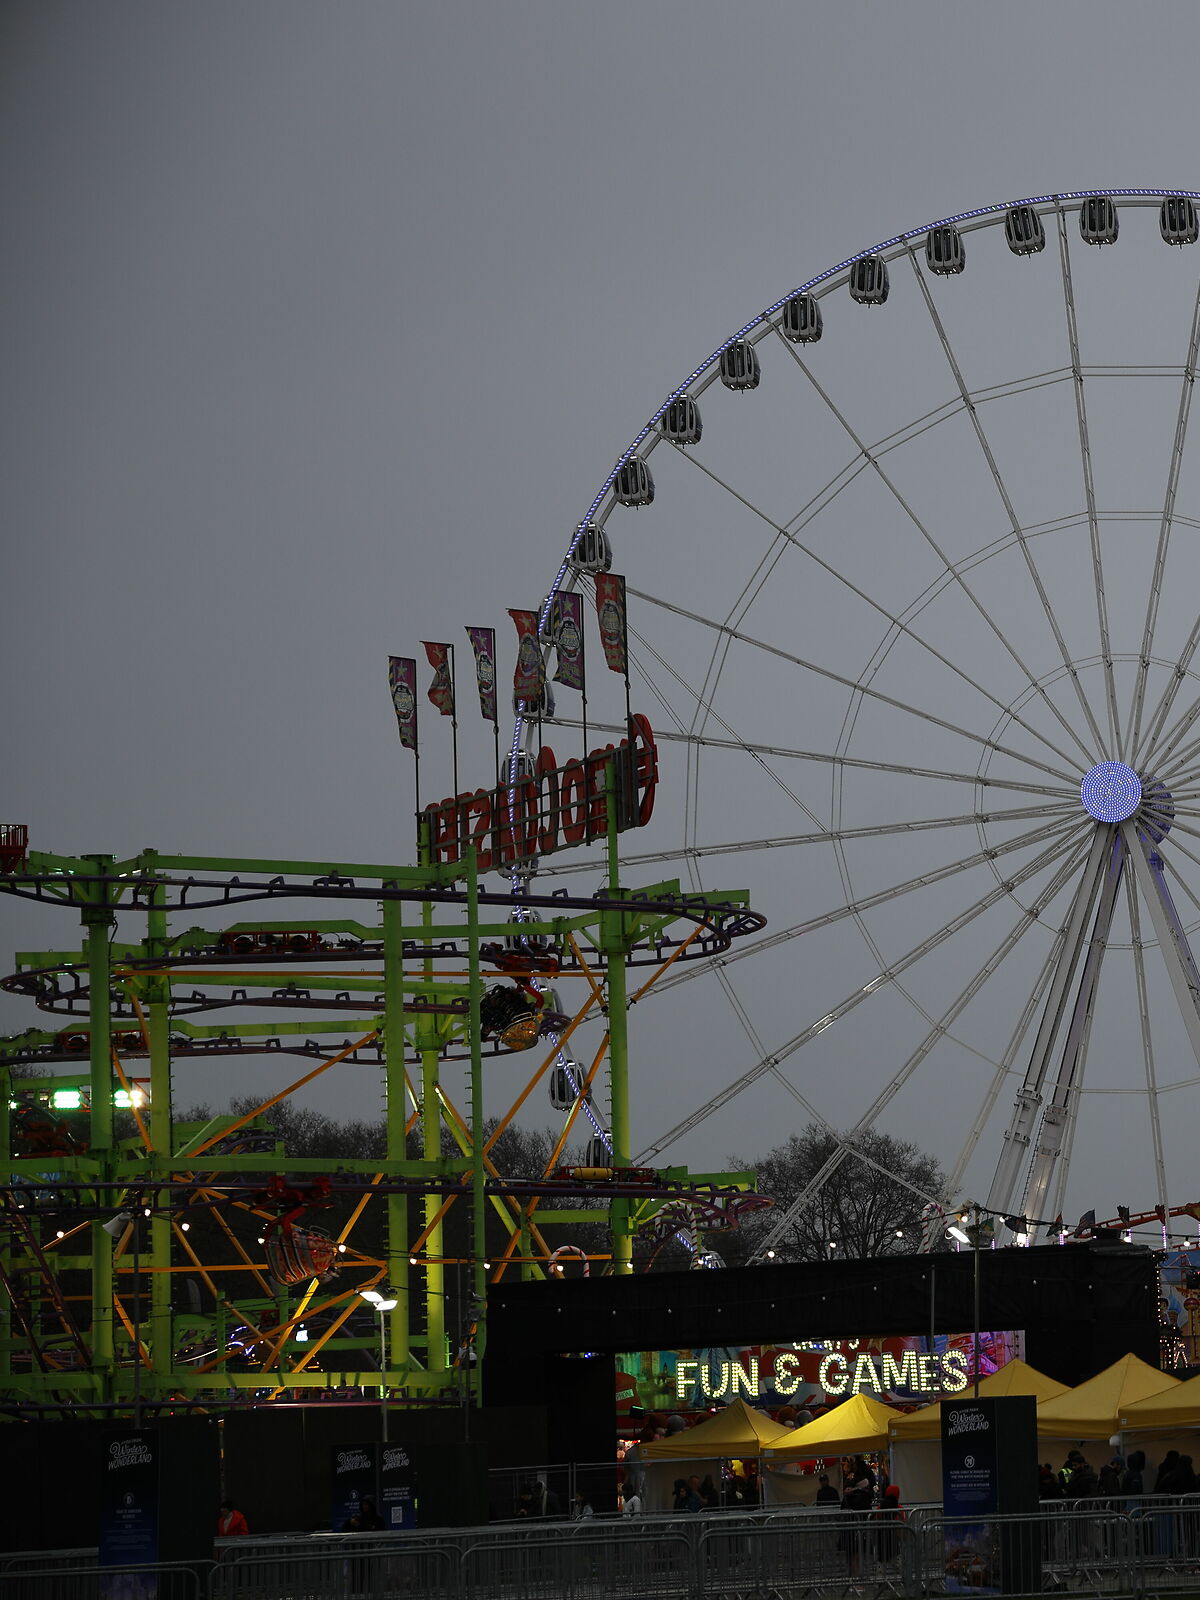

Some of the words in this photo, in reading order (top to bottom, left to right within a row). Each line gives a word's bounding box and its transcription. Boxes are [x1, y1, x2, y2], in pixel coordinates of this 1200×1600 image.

[675, 1355, 761, 1400] FUN
[819, 1349, 968, 1396] GAMES
[948, 1421, 989, 1436] WONDERLAND
